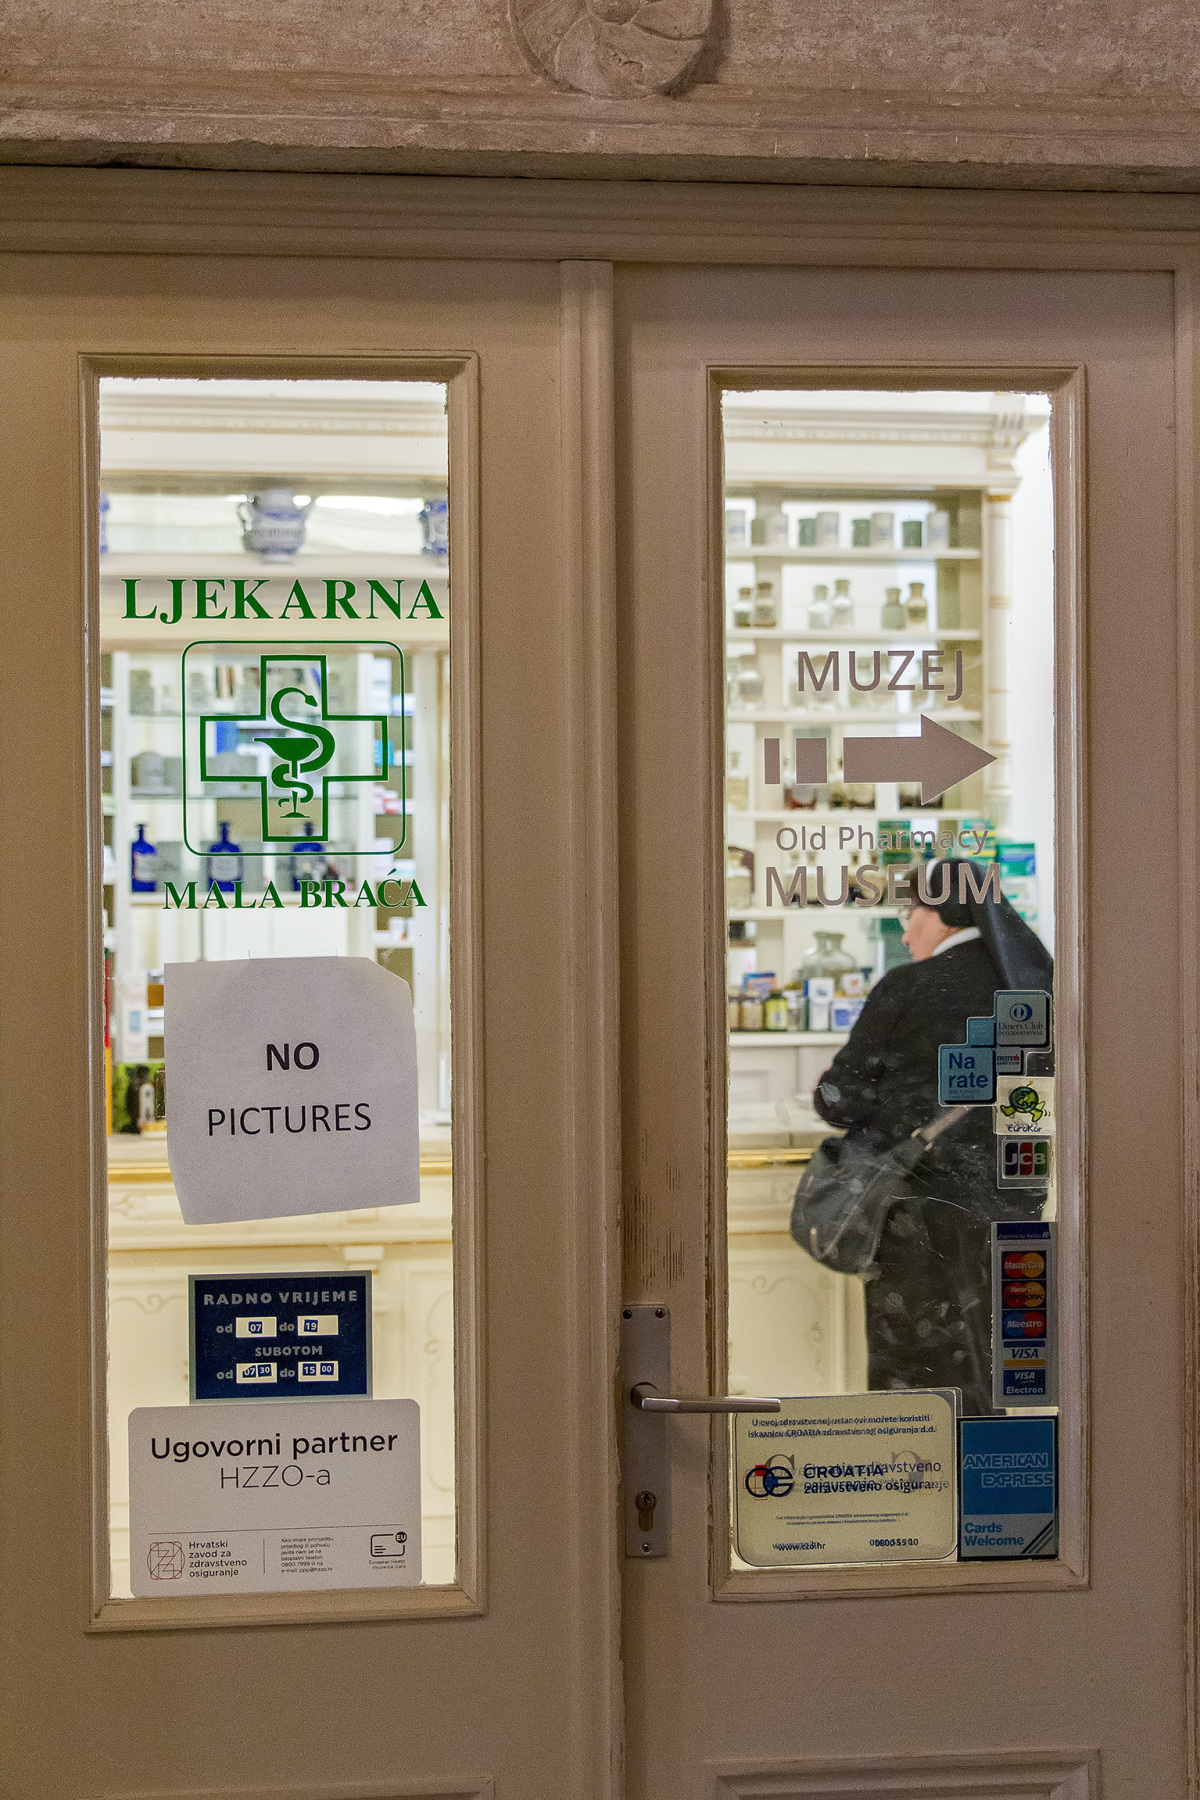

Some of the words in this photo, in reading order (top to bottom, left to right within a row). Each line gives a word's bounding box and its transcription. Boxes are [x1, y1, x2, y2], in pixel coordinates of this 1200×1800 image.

[121, 578, 444, 624] LJEKARNA
[797, 650, 963, 701] MUZEJ
[775, 825, 826, 851] Old
[838, 825, 988, 855] Pharmacy
[163, 881, 285, 910] MALA
[298, 868, 428, 908] BRAĆA
[766, 862, 1001, 907] MUSEUM
[1025, 1021, 1044, 1030] Club
[265, 1041, 320, 1071] NO
[948, 1052, 975, 1069] Na
[948, 1072, 988, 1088] rate
[206, 1102, 373, 1136] PICTURES
[1004, 1152, 1046, 1165] JCB
[203, 1292, 272, 1305] RADNO
[279, 1290, 357, 1305] VRIJEME
[216, 1323, 233, 1334] od
[249, 1323, 262, 1332] 07
[279, 1322, 295, 1332] do
[305, 1321, 317, 1330] 19
[1007, 1320, 1042, 1328] Maestro
[254, 1345, 323, 1357] SUBOTOM
[1011, 1348, 1038, 1358] VISA
[216, 1369, 233, 1380] od
[259, 1365, 271, 1374] 30
[279, 1367, 296, 1378] do
[303, 1366, 315, 1374] 15
[321, 1365, 332, 1373] 00
[1014, 1371, 1035, 1380] VISA
[1006, 1386, 1043, 1394] Electron
[150, 1434, 281, 1464] Ugovorni
[292, 1431, 399, 1460] partner
[963, 1453, 1048, 1469] AMERICAN
[219, 1465, 331, 1491] HZZO-a
[982, 1472, 1053, 1488] EXPRESS
[964, 1522, 1002, 1534] Cards
[188, 1540, 228, 1549] Hrvatski
[964, 1535, 1025, 1547] Welcome
[189, 1550, 218, 1559] zavod
[220, 1550, 231, 1558] za
[189, 1559, 248, 1568] zdravstveno
[189, 1569, 239, 1579] osiguranje
